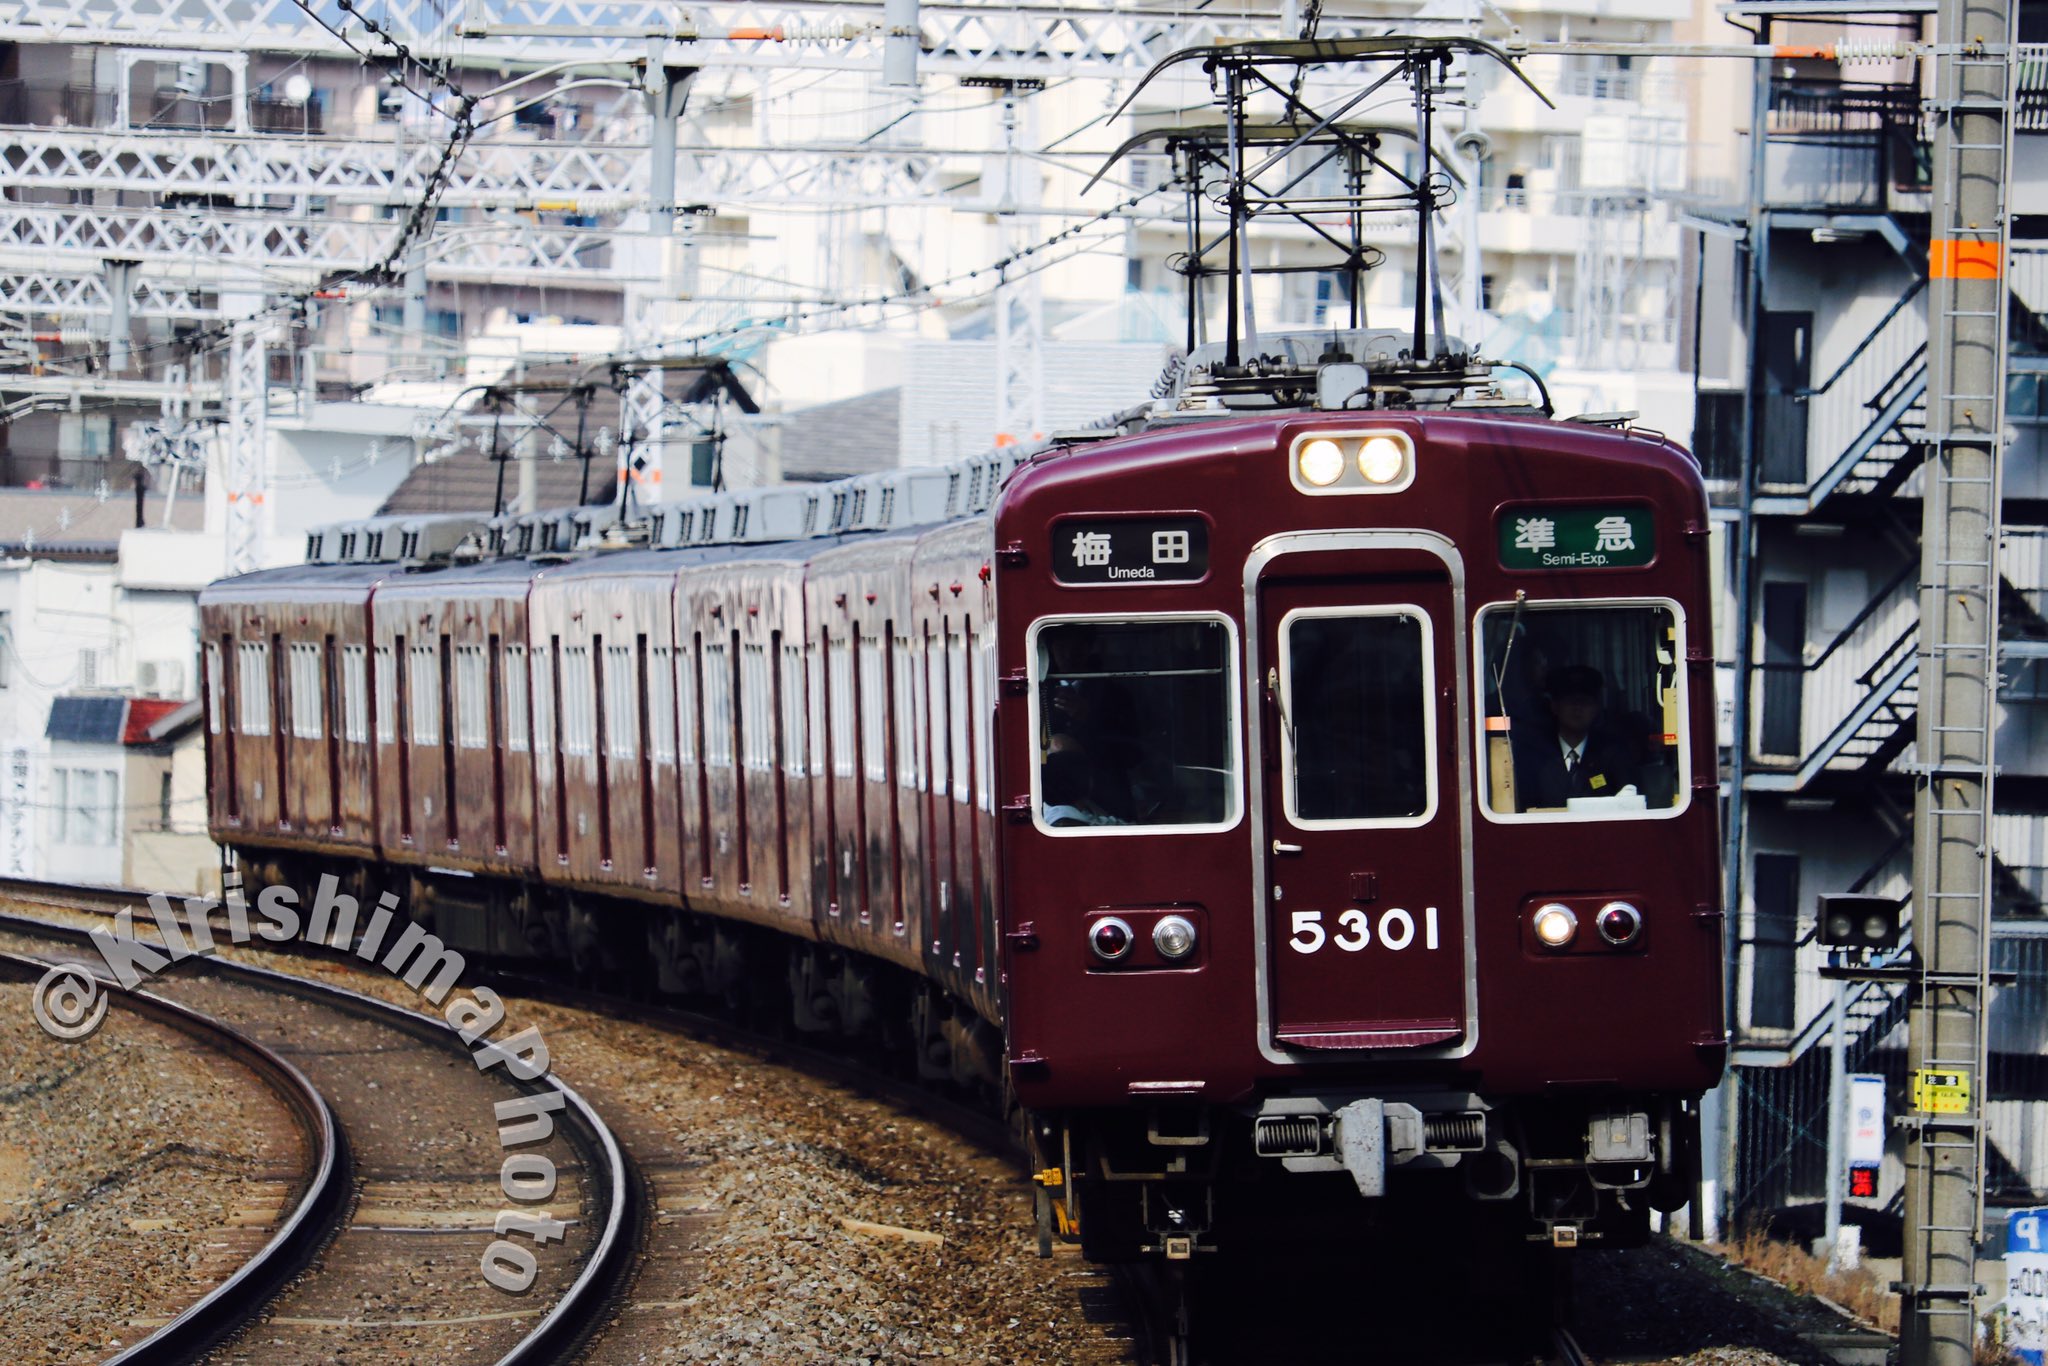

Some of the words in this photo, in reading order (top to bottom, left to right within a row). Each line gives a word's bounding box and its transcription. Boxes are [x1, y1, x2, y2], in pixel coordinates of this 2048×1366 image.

[1072, 530, 1190, 567] 梅田
[1515, 516, 1635, 553] 準急
[1108, 566, 1155, 578] Umeda
[1542, 552, 1609, 566] Semi-Exp.
[1289, 907, 1439, 954] 5301
